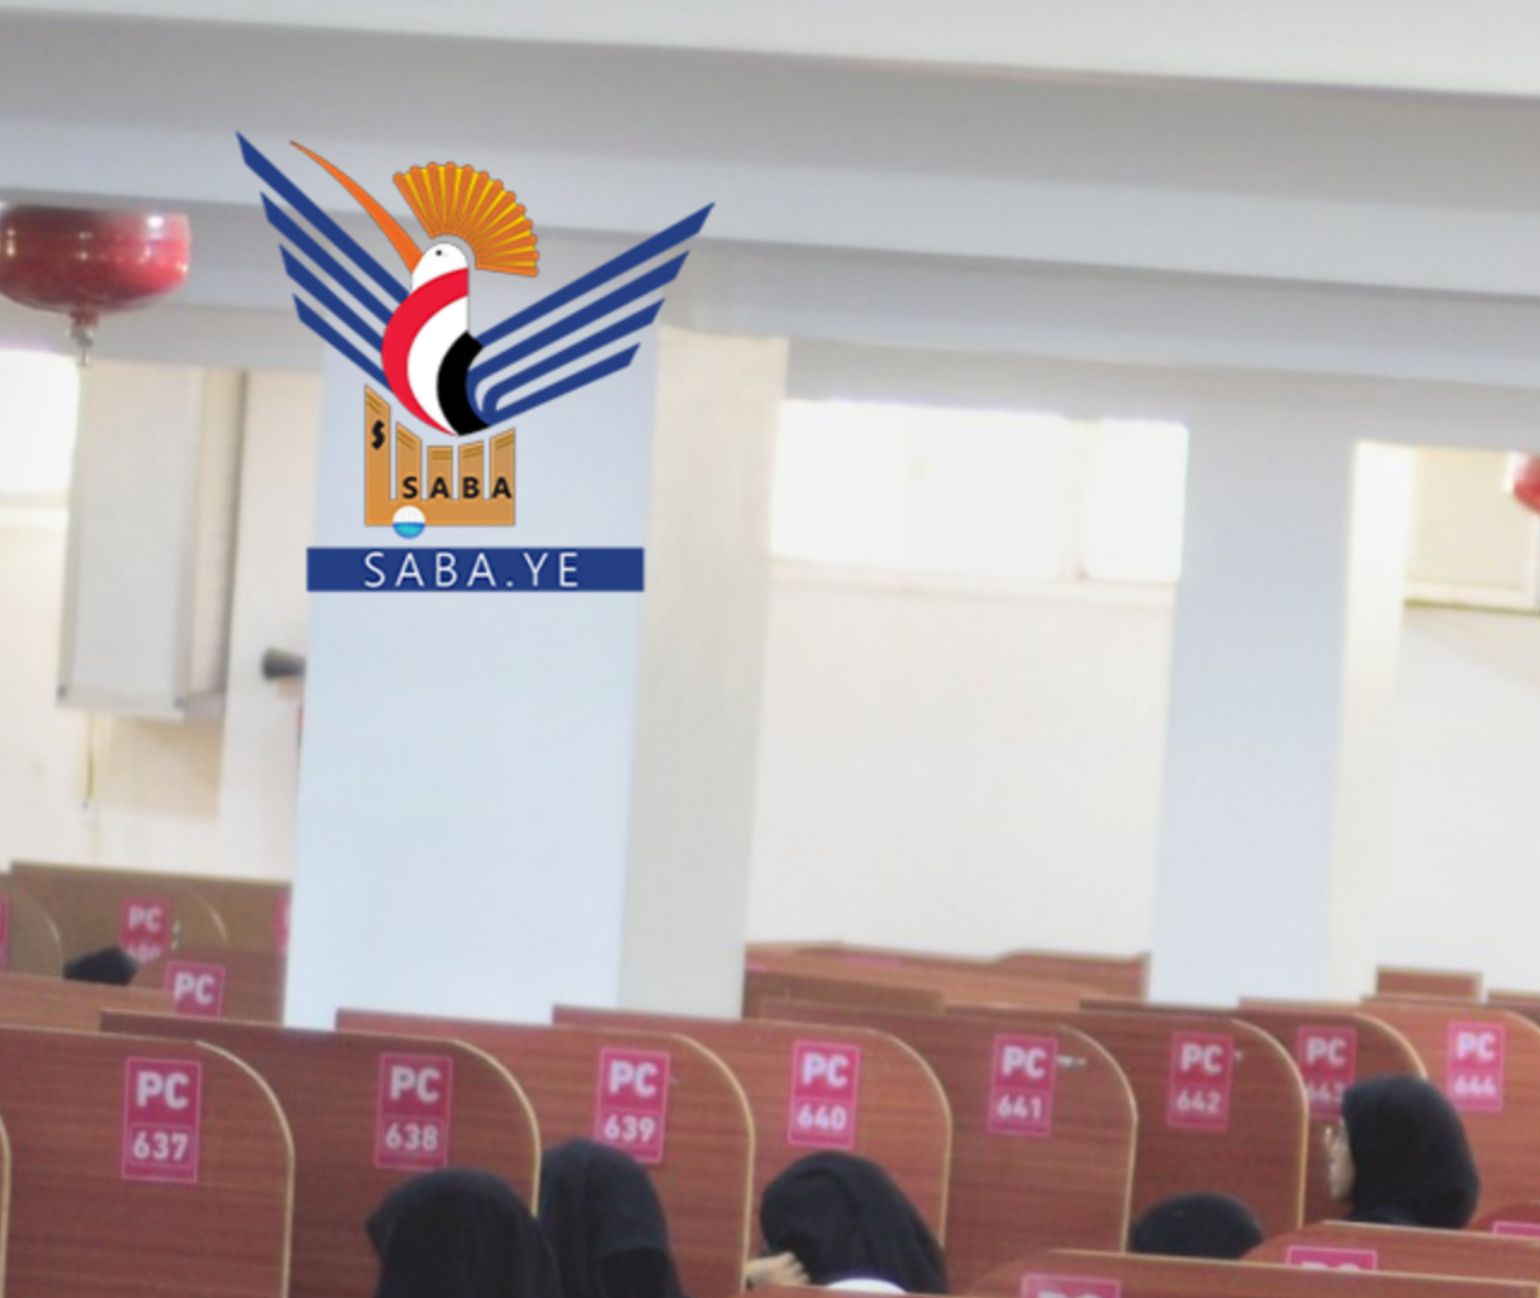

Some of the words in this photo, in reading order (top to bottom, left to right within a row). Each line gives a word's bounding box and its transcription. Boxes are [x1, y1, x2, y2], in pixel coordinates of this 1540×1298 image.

[128, 906, 162, 933] PC
[173, 971, 215, 1005] PC
[1180, 1044, 1223, 1075] PC
[1306, 1037, 1346, 1067] PC
[1455, 1032, 1495, 1061] PC
[802, 1052, 849, 1088] PC
[1002, 1046, 1047, 1078] PC
[135, 1070, 190, 1109] PC
[388, 1066, 441, 1103] PC
[608, 1060, 658, 1097] PC
[797, 1104, 847, 1131] 640
[997, 1092, 1042, 1120] 641
[1177, 1090, 1220, 1116] 642
[384, 1122, 438, 1151] 638
[604, 1114, 656, 1142] 639
[132, 1130, 189, 1161] 637
